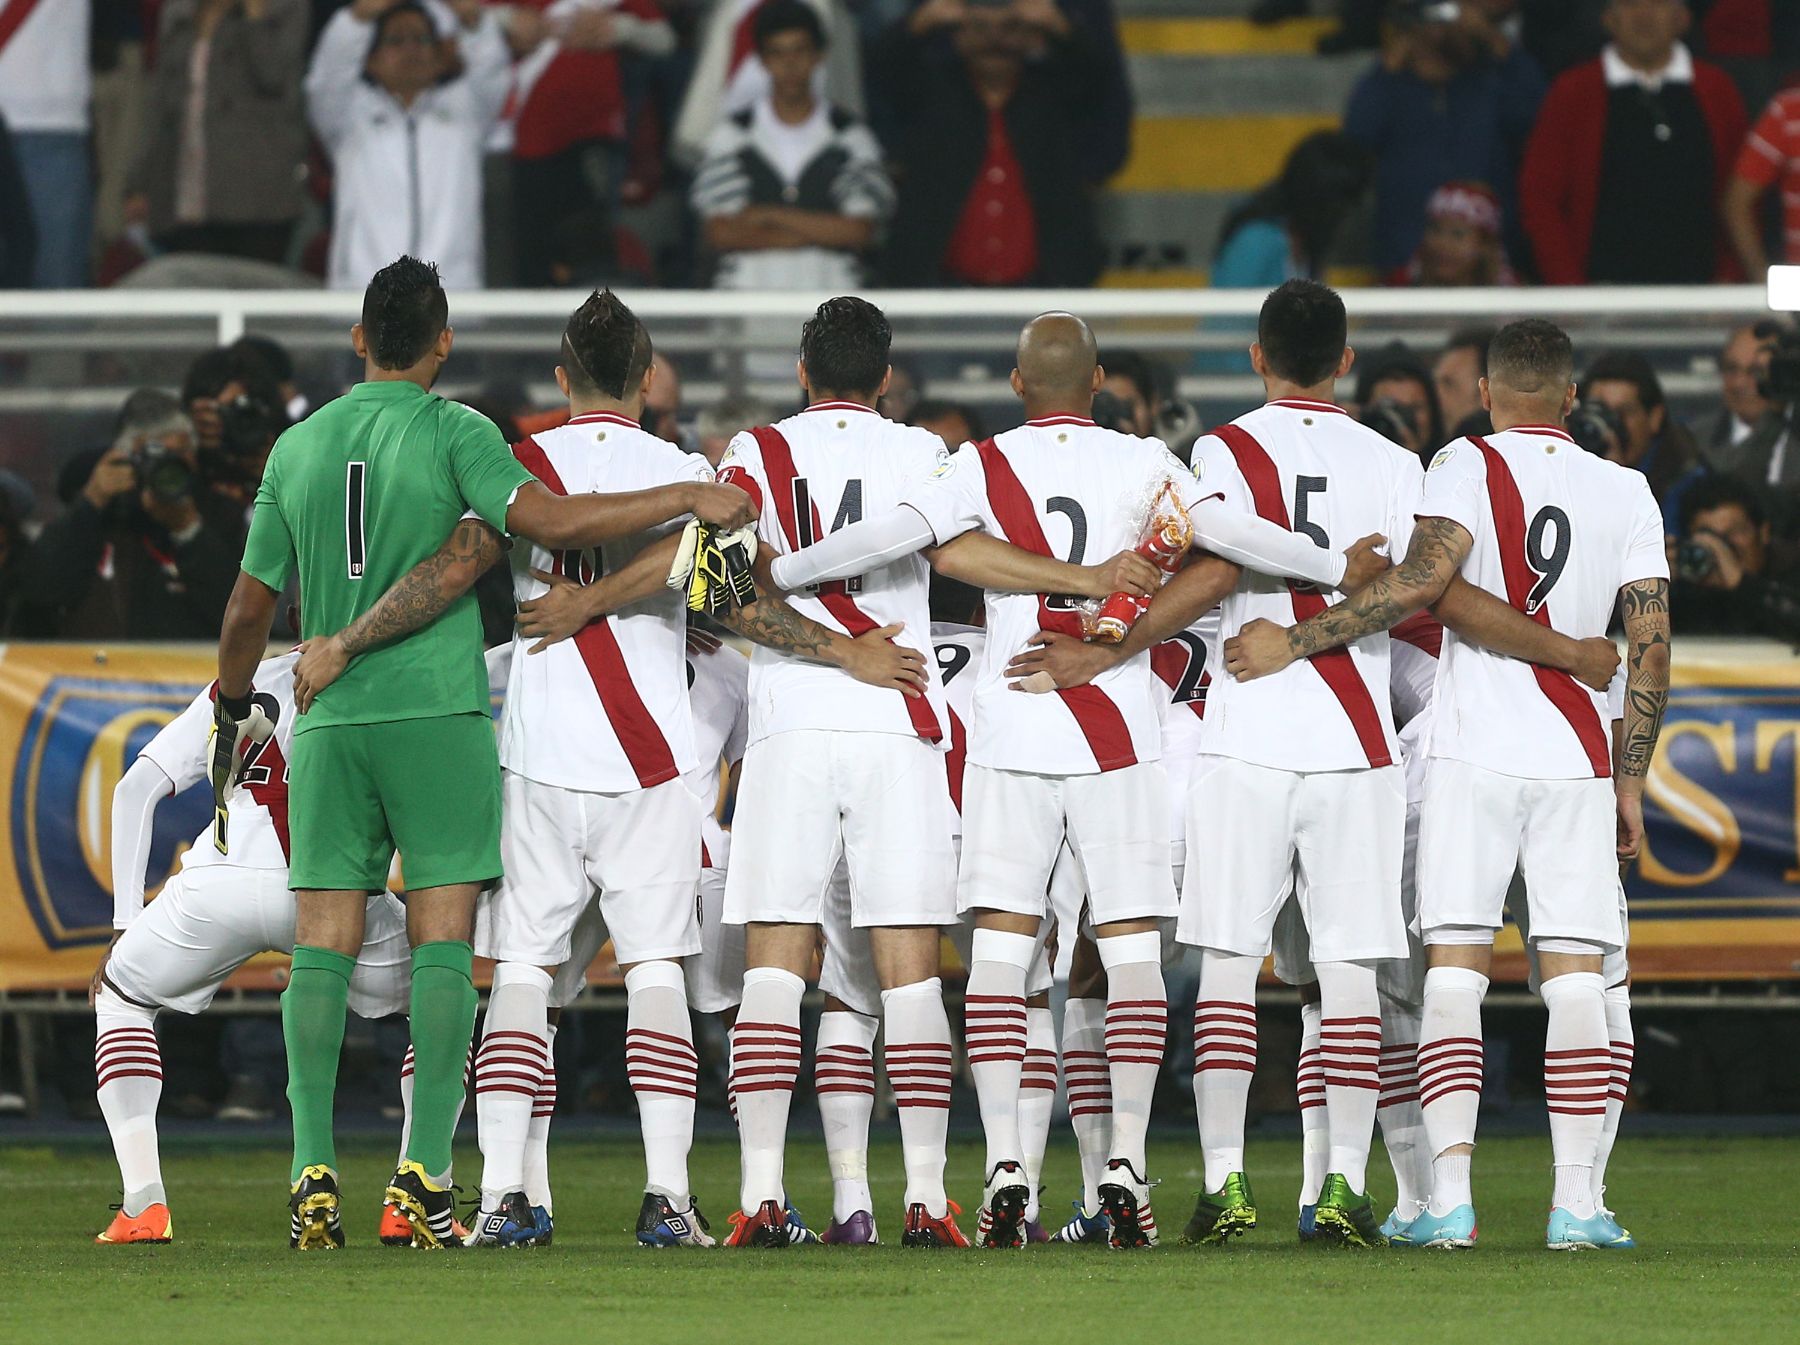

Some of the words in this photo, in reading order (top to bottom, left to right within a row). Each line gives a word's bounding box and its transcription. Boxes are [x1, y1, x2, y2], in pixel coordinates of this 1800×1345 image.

[337, 461, 366, 580] 1
[791, 475, 864, 594] 14
[1044, 494, 1090, 612] 2
[1293, 473, 1331, 590] 5
[1526, 504, 1573, 615] 9
